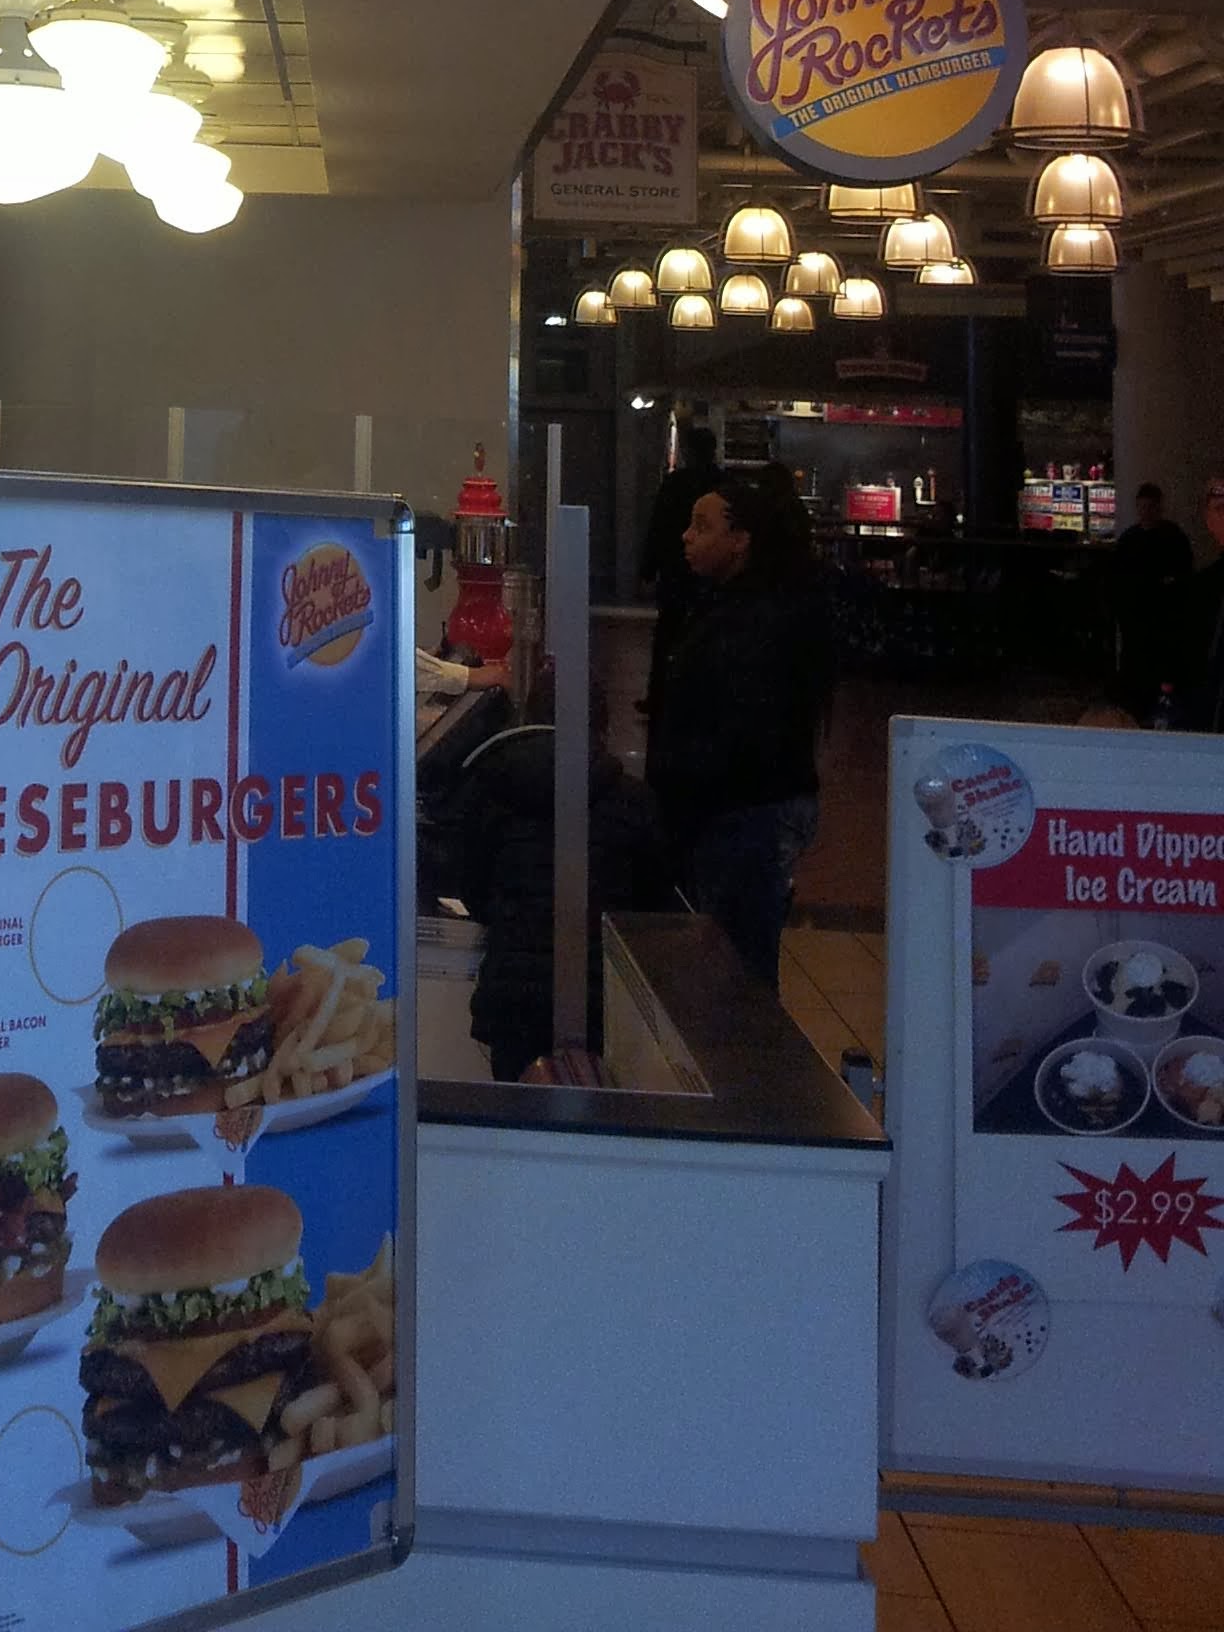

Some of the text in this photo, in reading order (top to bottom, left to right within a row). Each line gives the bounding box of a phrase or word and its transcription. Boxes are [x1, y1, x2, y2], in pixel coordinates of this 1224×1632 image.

[788, 51, 993, 128] THE ORIGINAL HAMBURGER
[545, 111, 687, 144] CRABBY
[551, 142, 674, 177] JACK'S
[550, 183, 681, 198] GENERAL STORE
[1047, 818, 1125, 858] Hand
[1065, 865, 1217, 907] Ice Cream
[9, 1015, 47, 1031] BACON
[1093, 1188, 1196, 1230] $2.99
